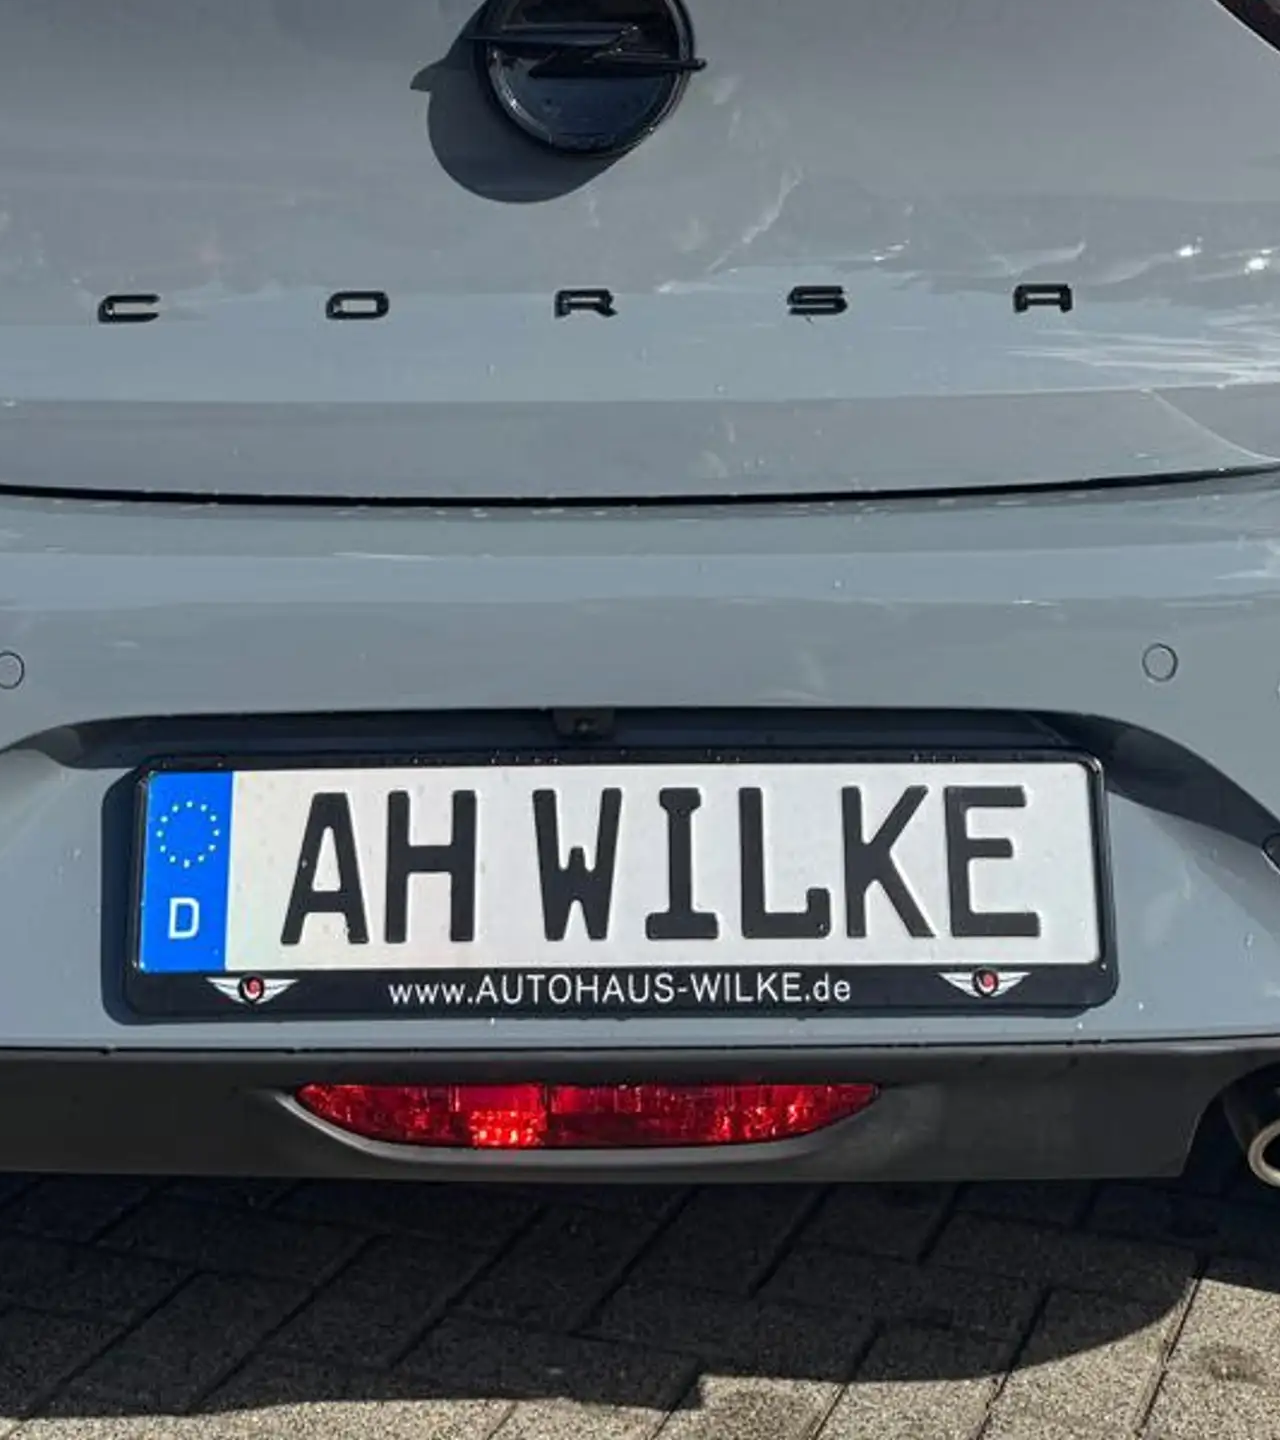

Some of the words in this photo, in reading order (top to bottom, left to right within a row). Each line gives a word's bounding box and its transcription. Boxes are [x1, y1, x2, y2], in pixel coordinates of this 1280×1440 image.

[98, 285, 1073, 325] CORSA
[281, 790, 476, 944] AH
[533, 786, 1040, 941] WILKE
[170, 898, 199, 939] D
[389, 973, 851, 1005] www.AUTOHAUS-WILKE.de
